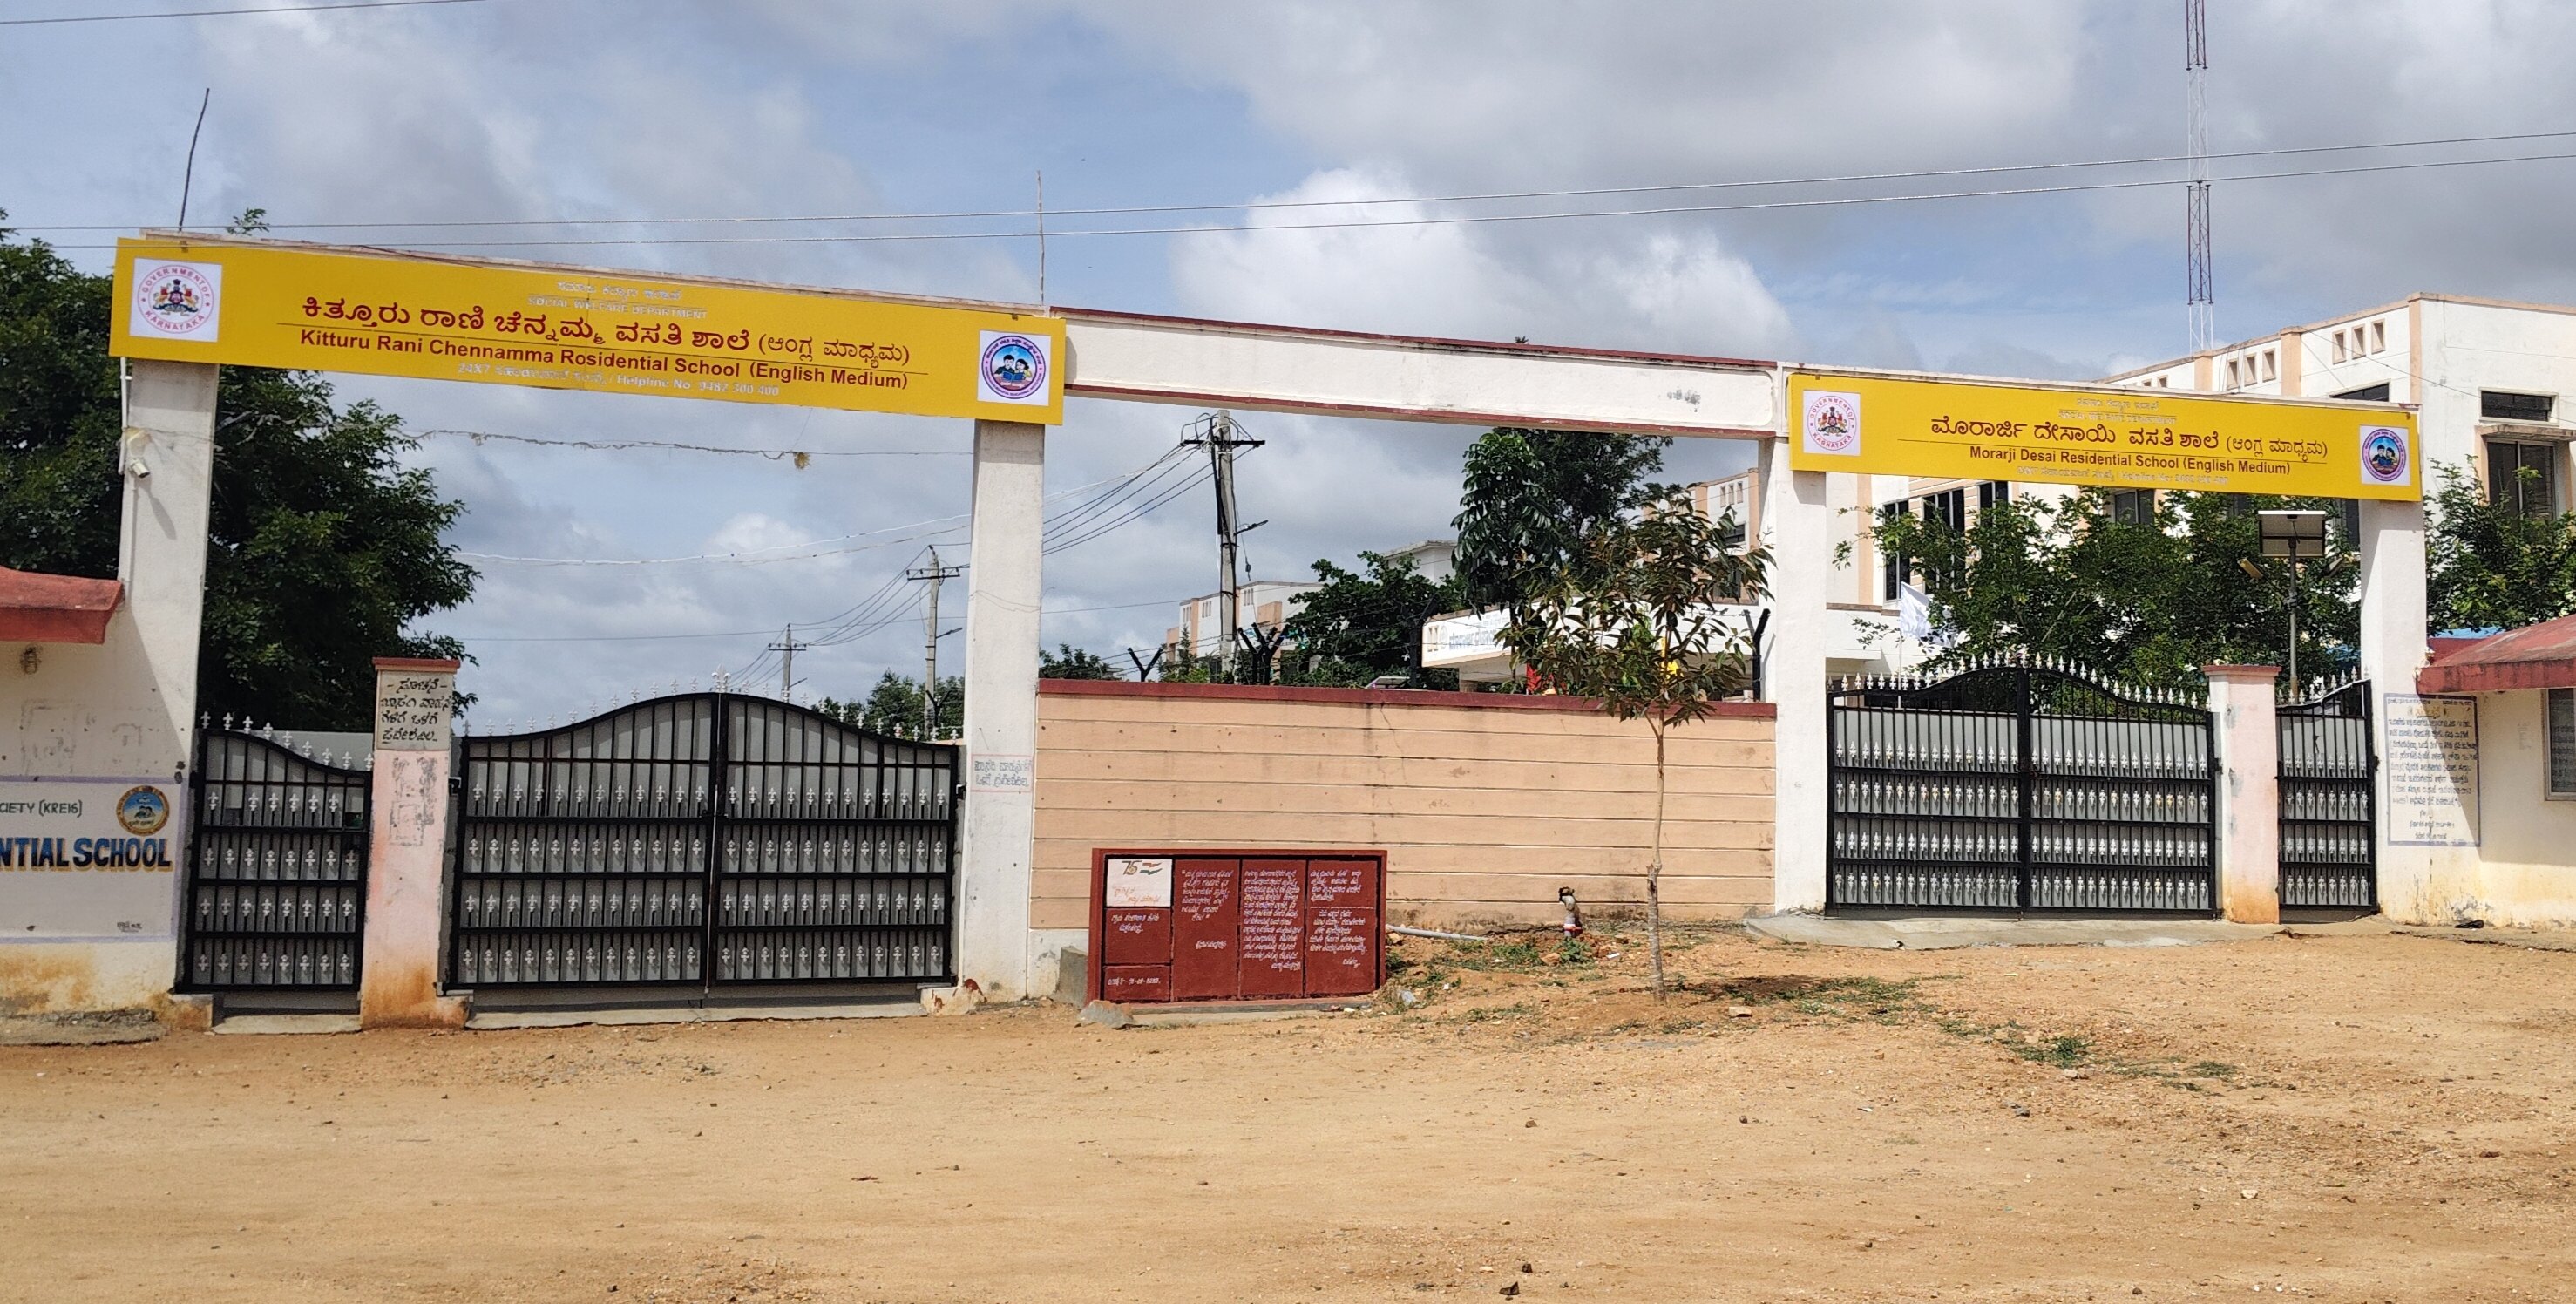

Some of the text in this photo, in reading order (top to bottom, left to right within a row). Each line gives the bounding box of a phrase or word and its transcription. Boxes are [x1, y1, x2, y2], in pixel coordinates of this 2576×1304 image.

[145, 310, 205, 330] KARNATAKA
[528, 296, 708, 320] SOCIAL WELFARE DEPARTMENT
[302, 296, 910, 369] ಕಿತ್ತೂರು ರಾಣಿ ಚೆನ್ನಮ್ಮ ವಸತಿ ಶಾಲೆ (ಆಂಗ್ಲ ಮಾಧ್ಯಮ)
[300, 329, 908, 391] Kitturu Rani Chennamma Rosidential School (English Medium)
[616, 374, 670, 389] Helpline
[1931, 415, 2329, 463] ಮೊರಾರ್ಜಿ ದೇಸಾಯಿ ವಸತಿ ಶಾಲೆ (ಆಂಗ್ಲ ಮಾಧ್ಯಮ)
[1969, 445, 2291, 475] Morarji Desai Residential School (English Medium)
[38, 798, 84, 818] (KREIS)
[0, 837, 172, 870] NTIAL SCHOOL
